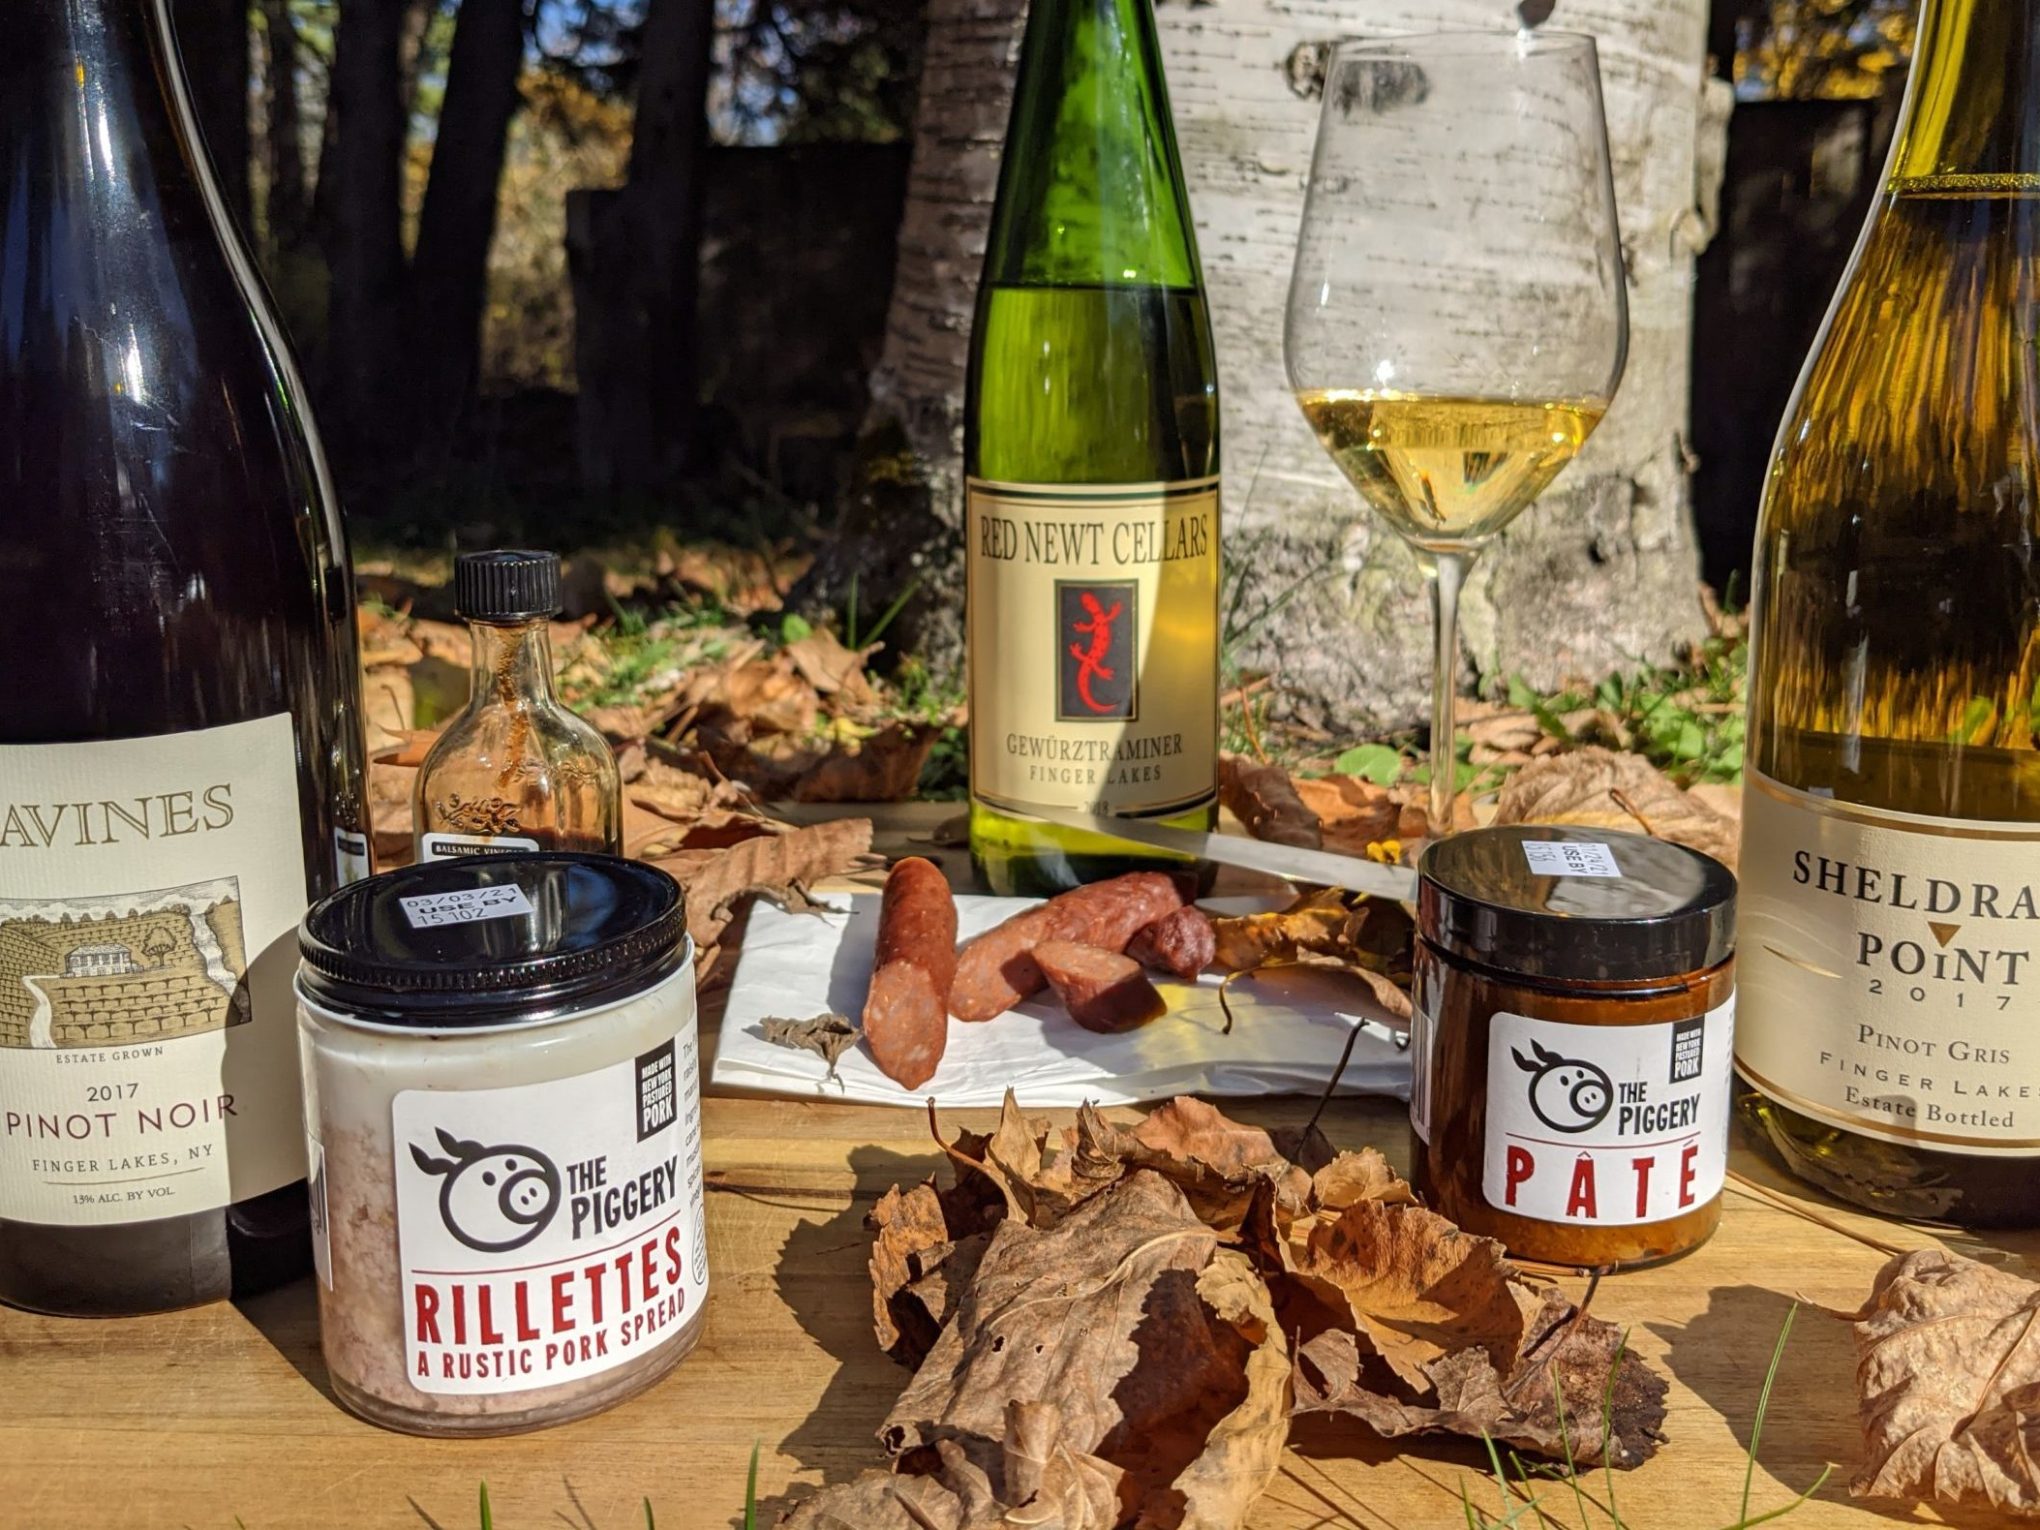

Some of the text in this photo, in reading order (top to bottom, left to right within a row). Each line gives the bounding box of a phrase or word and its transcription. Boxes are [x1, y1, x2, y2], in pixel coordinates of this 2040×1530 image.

[980, 513, 1208, 565] RED NEWT CELLARS
[1006, 733, 1183, 762] GEWÜRZTRAMINER
[1029, 764, 1161, 784] FINGER LAKES
[435, 844, 480, 855] BALSAMIC
[1562, 845, 1588, 875] USE BY
[406, 887, 517, 908] 03/03/21
[1793, 850, 2040, 919] SHELDRA
[419, 896, 517, 914] USE BY
[56, 1046, 164, 1064] ESTATE GROWN
[1675, 1041, 1688, 1052] NEW
[641, 1060, 659, 1080] MADE
[642, 1075, 658, 1095] NEW
[658, 1066, 672, 1087] YORK
[1674, 1056, 1699, 1079] PORK
[1819, 1051, 2040, 1098] FINGER LAKE
[86, 1082, 139, 1102] 2017
[642, 1080, 673, 1109] PASTURED
[1618, 1081, 1648, 1104] THE
[6, 1093, 238, 1140] PINOT NOIR
[643, 1093, 673, 1133] PORK
[1618, 1093, 1701, 1135] PIGGERY
[1845, 1085, 2015, 1129] Estate Bottled
[32, 1143, 214, 1174] FINGER LAKES, NY
[566, 1155, 607, 1194] THE
[1505, 1139, 1699, 1219] PÂTÉ
[73, 1194, 95, 1205] 13%
[98, 1192, 122, 1204] ALC.
[126, 1190, 144, 1201] BY
[571, 1155, 677, 1240] PIGGERY
[414, 1226, 682, 1345] RILLETTES
[417, 1287, 685, 1379] A RUSTIC PORK SPREAD
